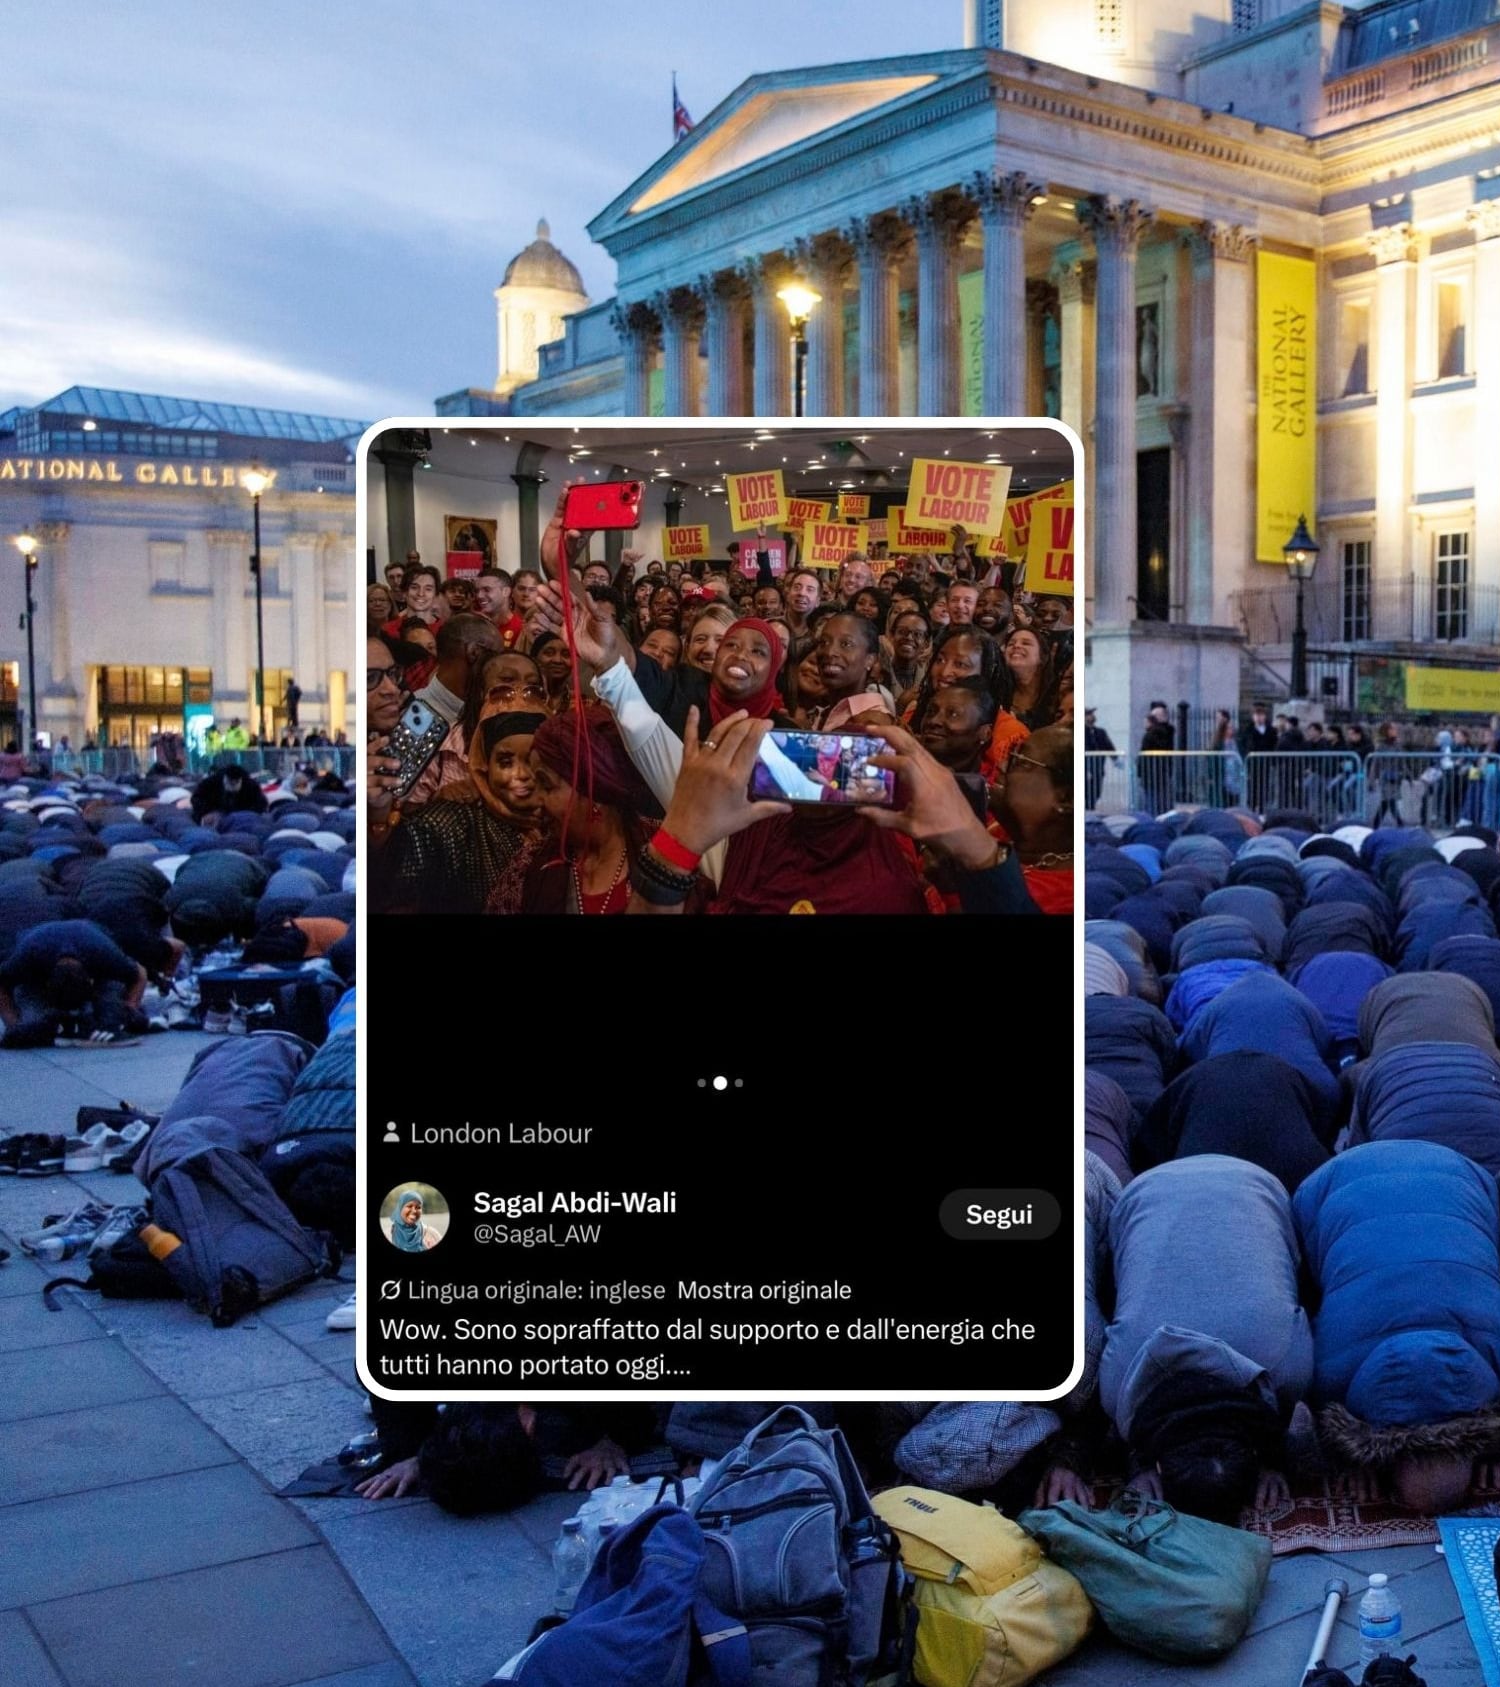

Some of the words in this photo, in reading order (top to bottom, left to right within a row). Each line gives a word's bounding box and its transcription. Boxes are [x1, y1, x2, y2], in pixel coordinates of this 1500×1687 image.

[1271, 304, 1287, 433] NATIONAL
[1288, 304, 1306, 438] GALLERY
[0, 459, 123, 482] ATIONAL
[925, 463, 996, 501] VOTE
[736, 474, 777, 503] VOTE
[739, 498, 779, 521] LABOUR
[789, 500, 824, 519] VOTE
[843, 496, 864, 507] VOTE
[919, 497, 990, 524] LABOUR
[668, 526, 702, 545] VOTE
[814, 525, 858, 548] VOTE
[897, 532, 947, 547] LABOUR
[669, 543, 704, 556] LABOUR
[812, 547, 848, 562] LABOU
